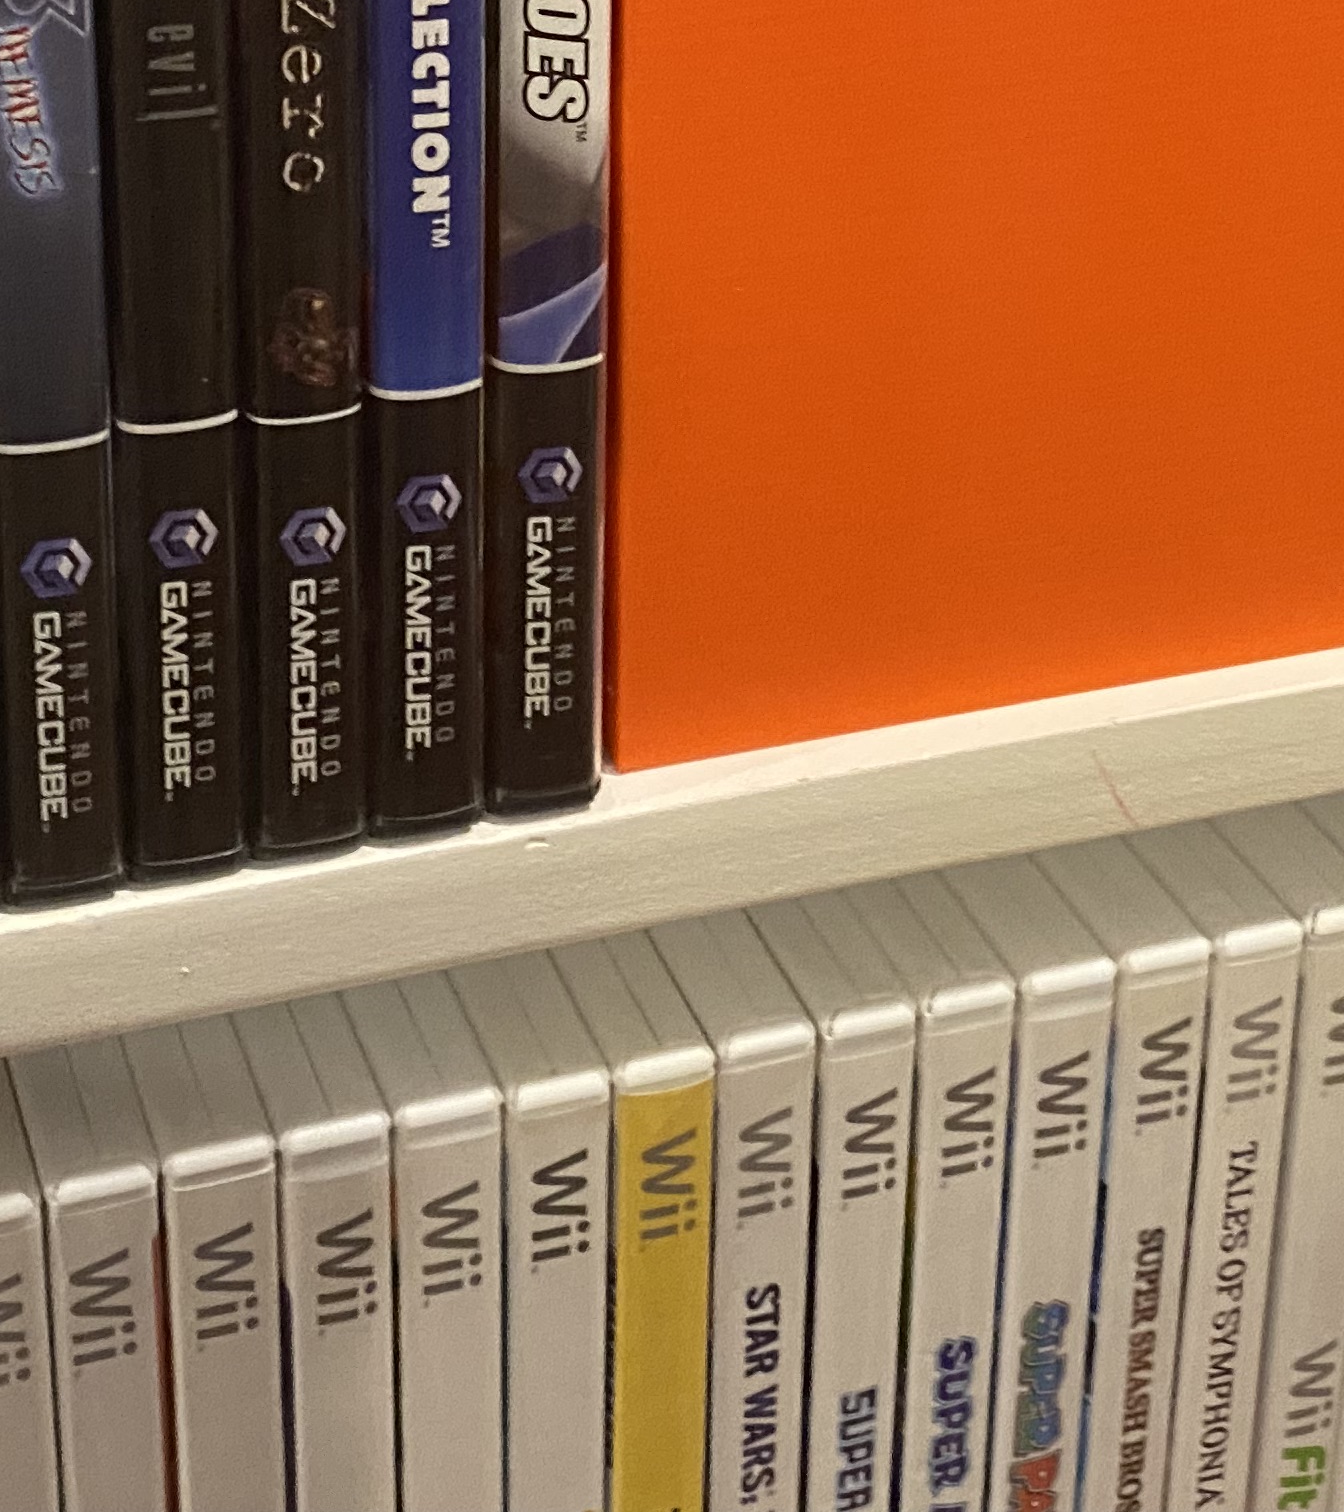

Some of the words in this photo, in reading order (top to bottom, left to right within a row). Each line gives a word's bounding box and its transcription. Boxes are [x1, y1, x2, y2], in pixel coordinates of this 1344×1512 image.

[136, 21, 221, 123] evil
[553, 516, 576, 712] NINTENDO
[1033, 1050, 1091, 1160] Wii
[1134, 1016, 1194, 1127] Wii
[1224, 995, 1283, 1104] Wii
[736, 1106, 795, 1221] Wii
[841, 1088, 897, 1201] Wii
[941, 1066, 998, 1180] Wii
[422, 1181, 482, 1296] Wii
[531, 1149, 590, 1263] Wii
[639, 1128, 697, 1240] Wii
[1219, 1140, 1260, 1254] TALES
[69, 1248, 138, 1366] Wii
[194, 1221, 259, 1340] Wii
[315, 1207, 378, 1326] Wii
[1130, 1226, 1165, 1330] SUPER
[1215, 1258, 1247, 1303] OF
[743, 1282, 782, 1378] STAR
[1121, 1329, 1157, 1435] SMASH
[929, 1336, 977, 1496] SUPER
[1193, 1307, 1242, 1510] SYMPHONIA
[1284, 1338, 1340, 1439] Wii
[836, 1385, 879, 1512] SUPER
[1276, 1445, 1327, 1512] Fit
